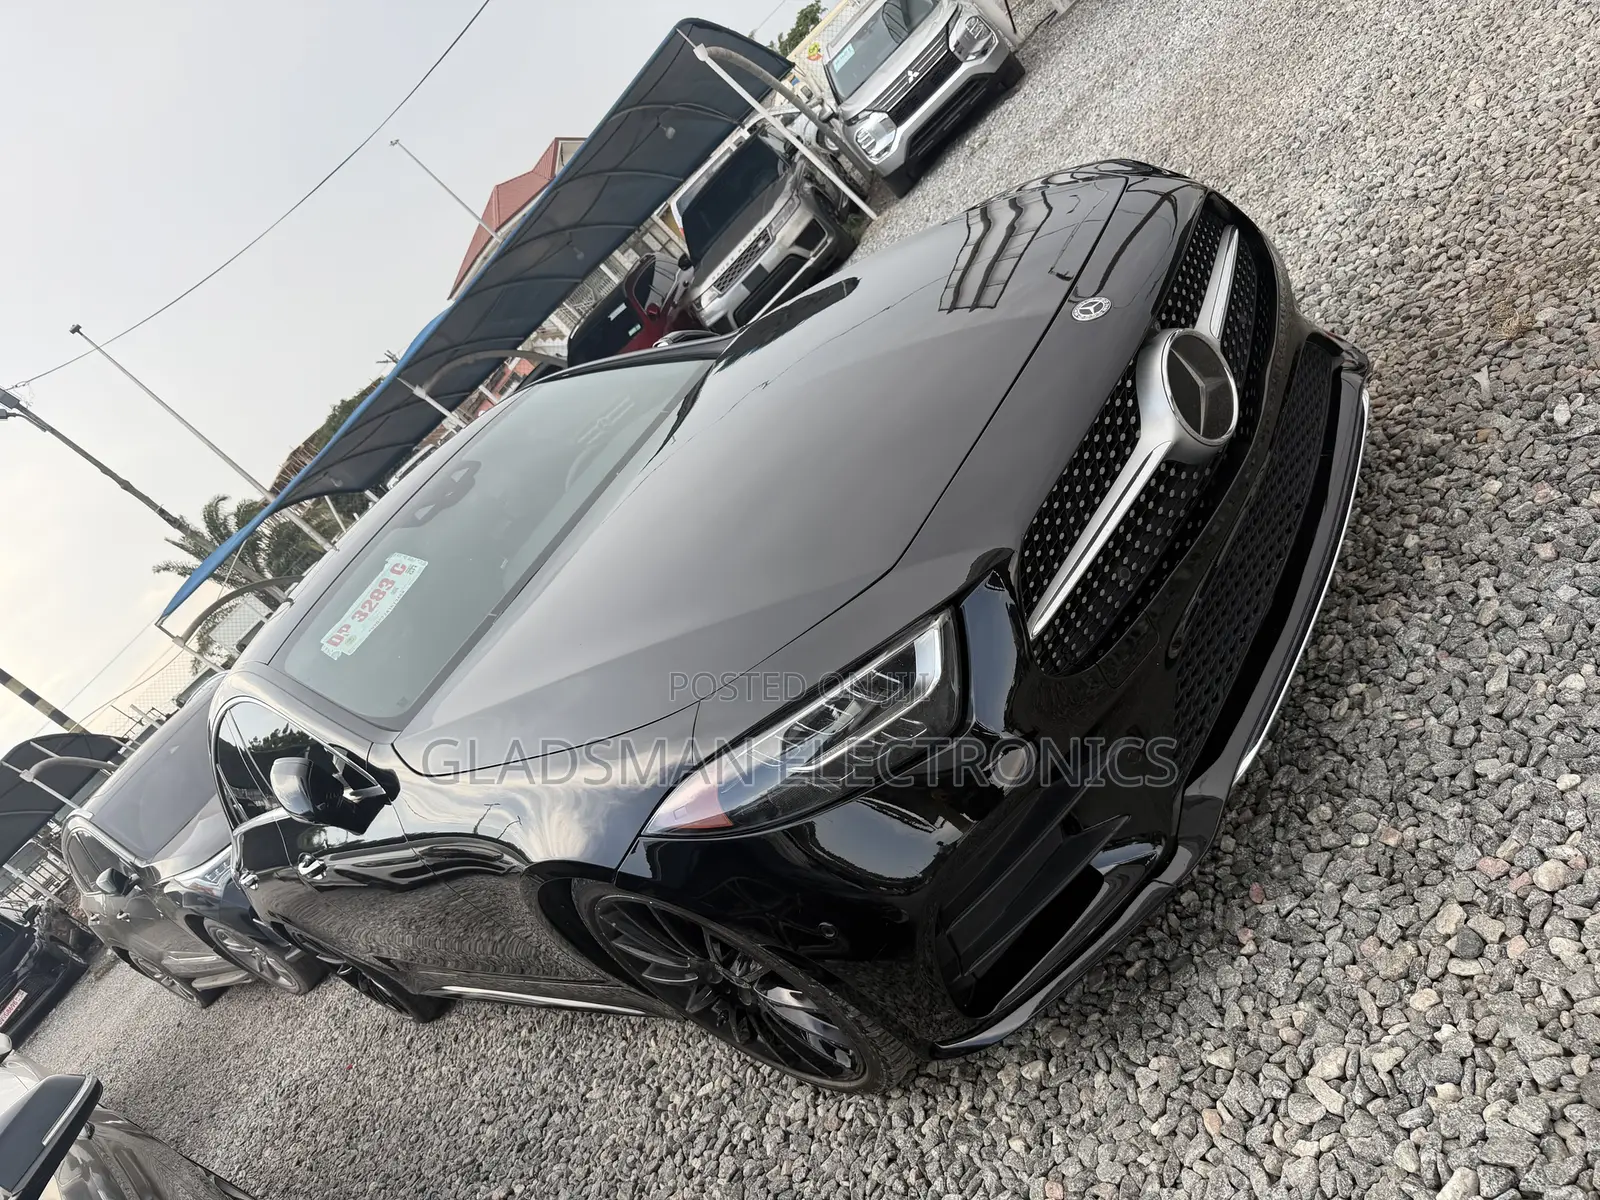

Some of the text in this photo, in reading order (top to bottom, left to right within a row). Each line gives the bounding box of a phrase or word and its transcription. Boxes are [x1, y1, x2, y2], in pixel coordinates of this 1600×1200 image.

[327, 624, 352, 648] DP
[351, 577, 396, 623] 3283
[390, 562, 407, 576] C
